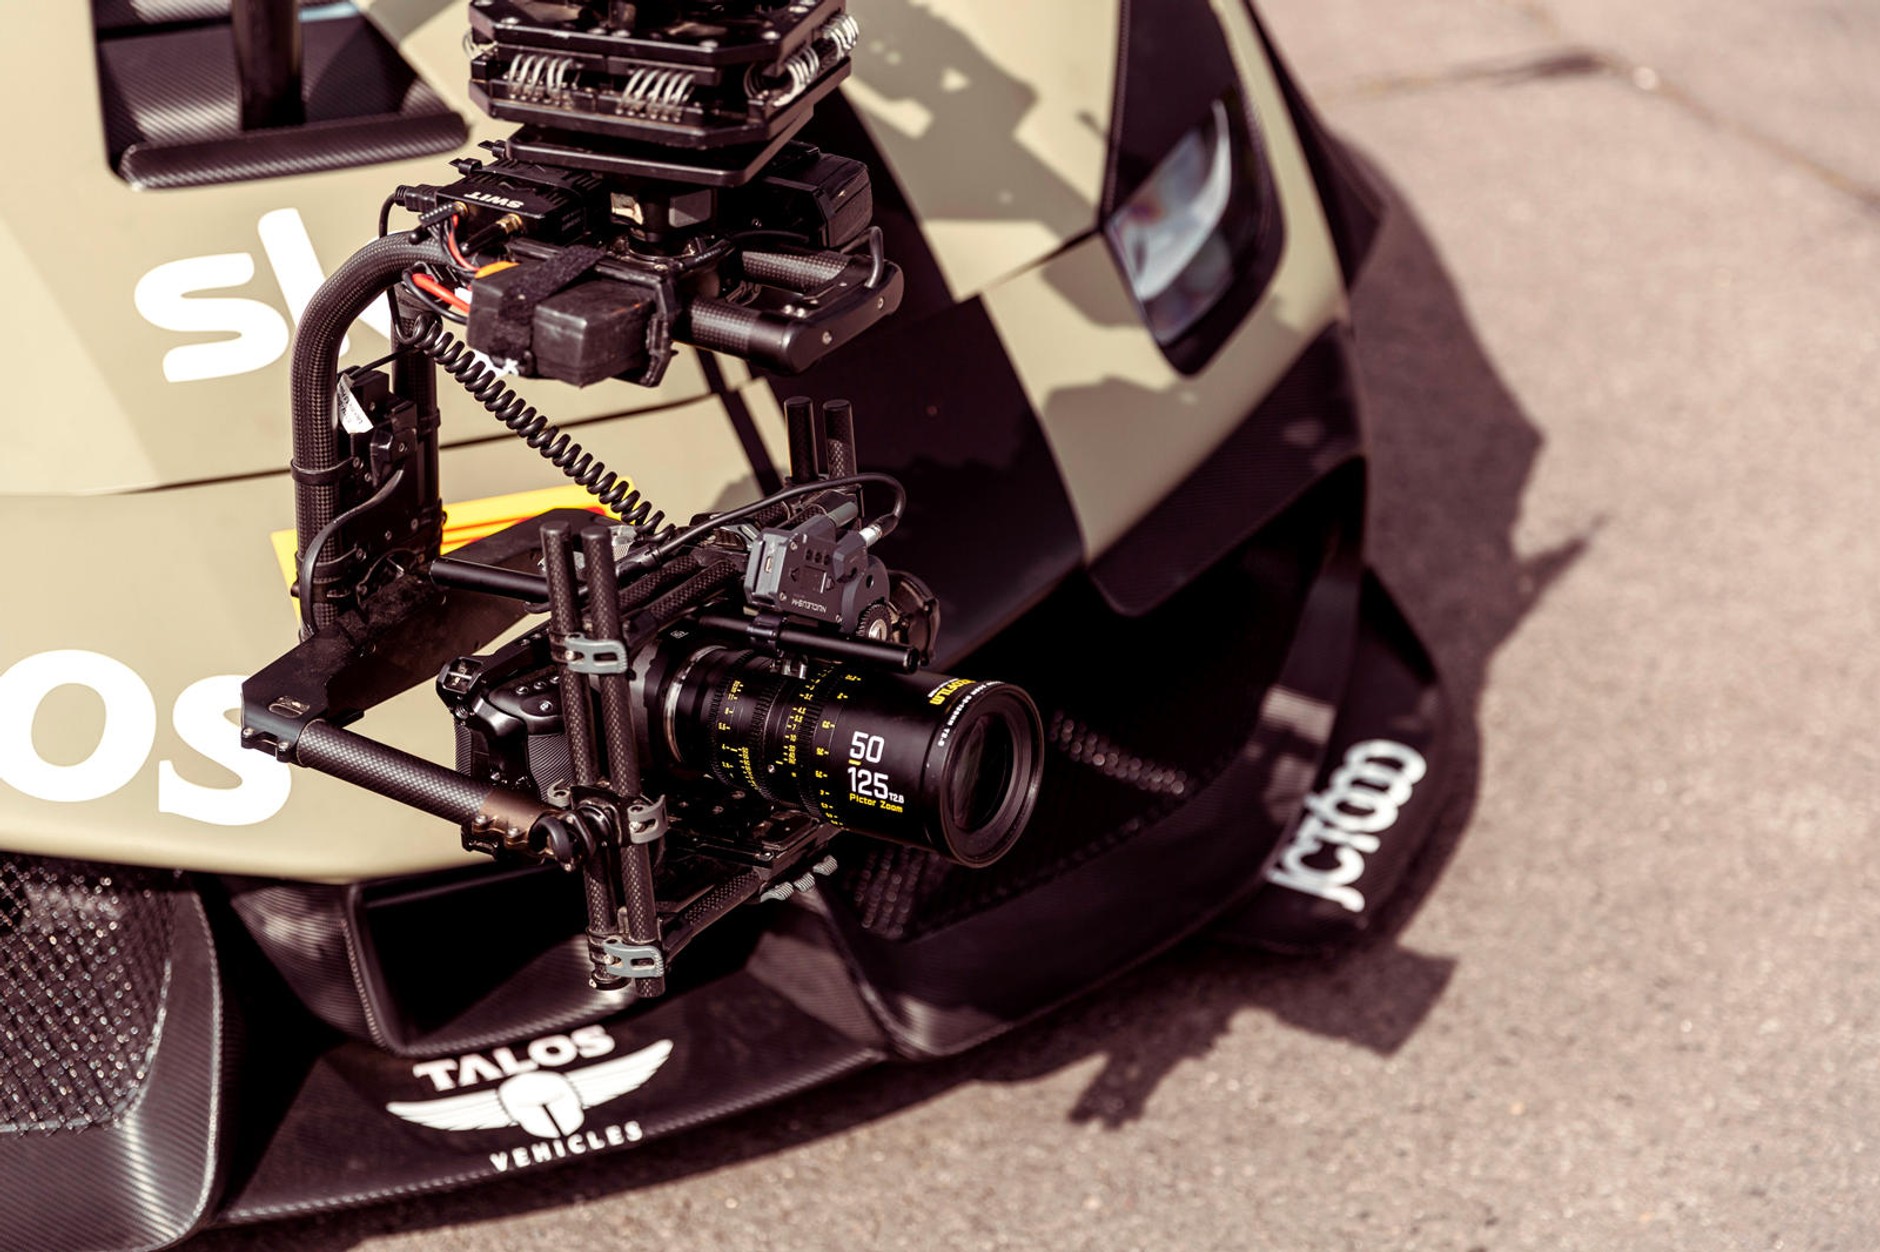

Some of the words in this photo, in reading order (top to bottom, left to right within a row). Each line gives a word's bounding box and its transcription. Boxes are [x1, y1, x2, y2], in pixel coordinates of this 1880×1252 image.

[463, 191, 525, 208] SWIT
[849, 730, 885, 764] 50
[847, 766, 889, 800] 125
[880, 800, 904, 813] Zoom
[412, 1024, 616, 1092] TALOS
[489, 1120, 643, 1172] VEHICLES
